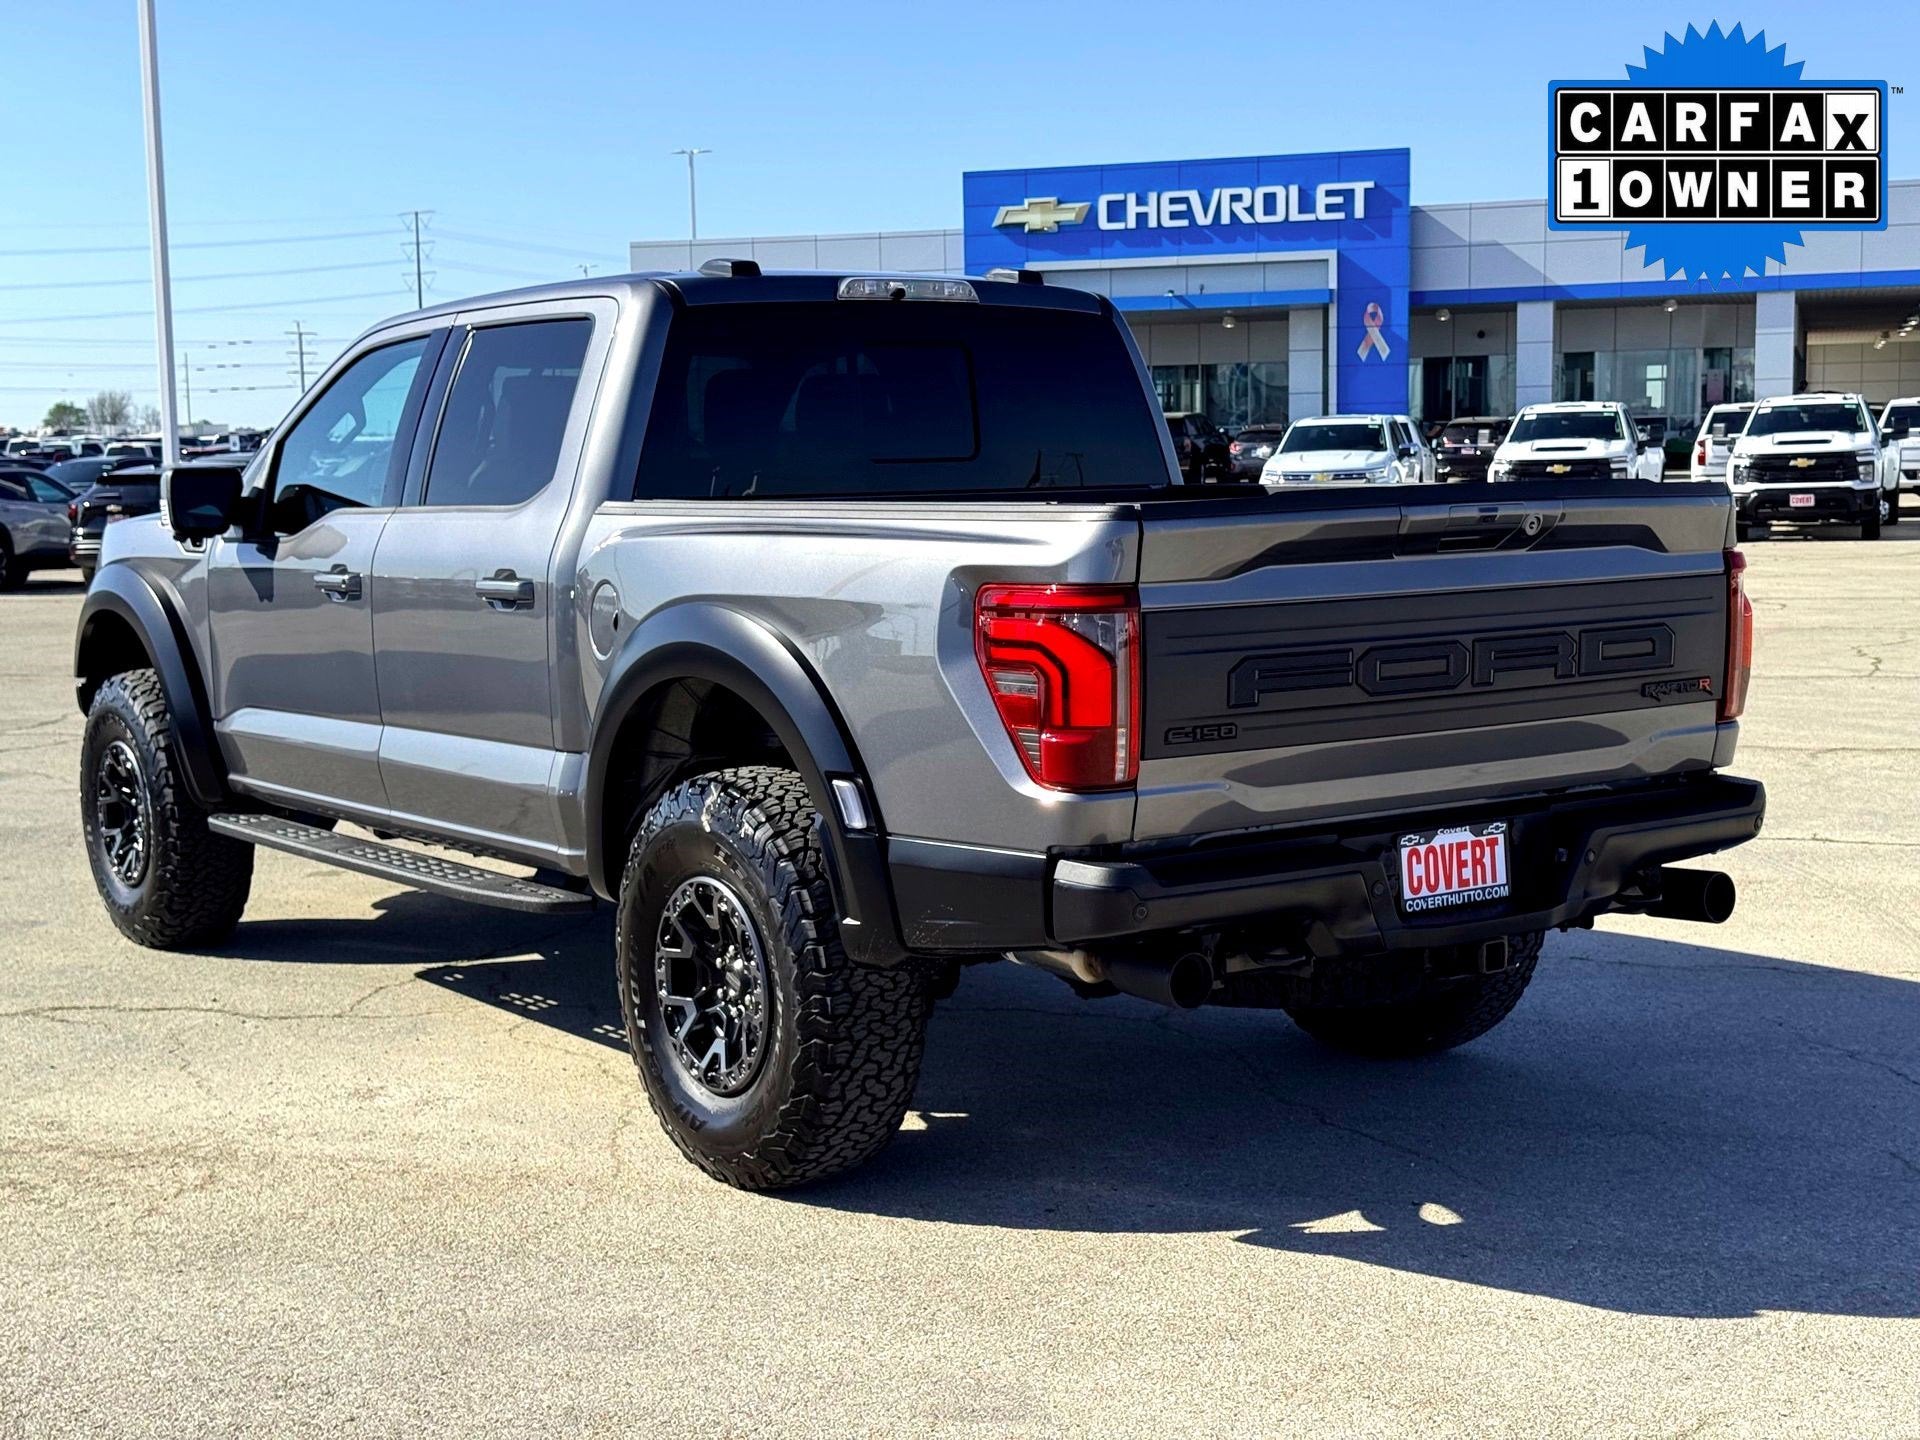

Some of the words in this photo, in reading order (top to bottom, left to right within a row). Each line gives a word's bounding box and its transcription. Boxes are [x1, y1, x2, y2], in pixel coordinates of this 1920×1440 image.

[1097, 180, 1375, 231] CHEVROLET
[1227, 622, 1676, 708] FORD
[1641, 677, 1713, 700] RAPTOR
[1164, 722, 1238, 745] F-150
[1437, 825, 1470, 836] Covert
[1406, 836, 1499, 896] COVERT
[1405, 885, 1509, 912] COVERTHUTTO.COM
